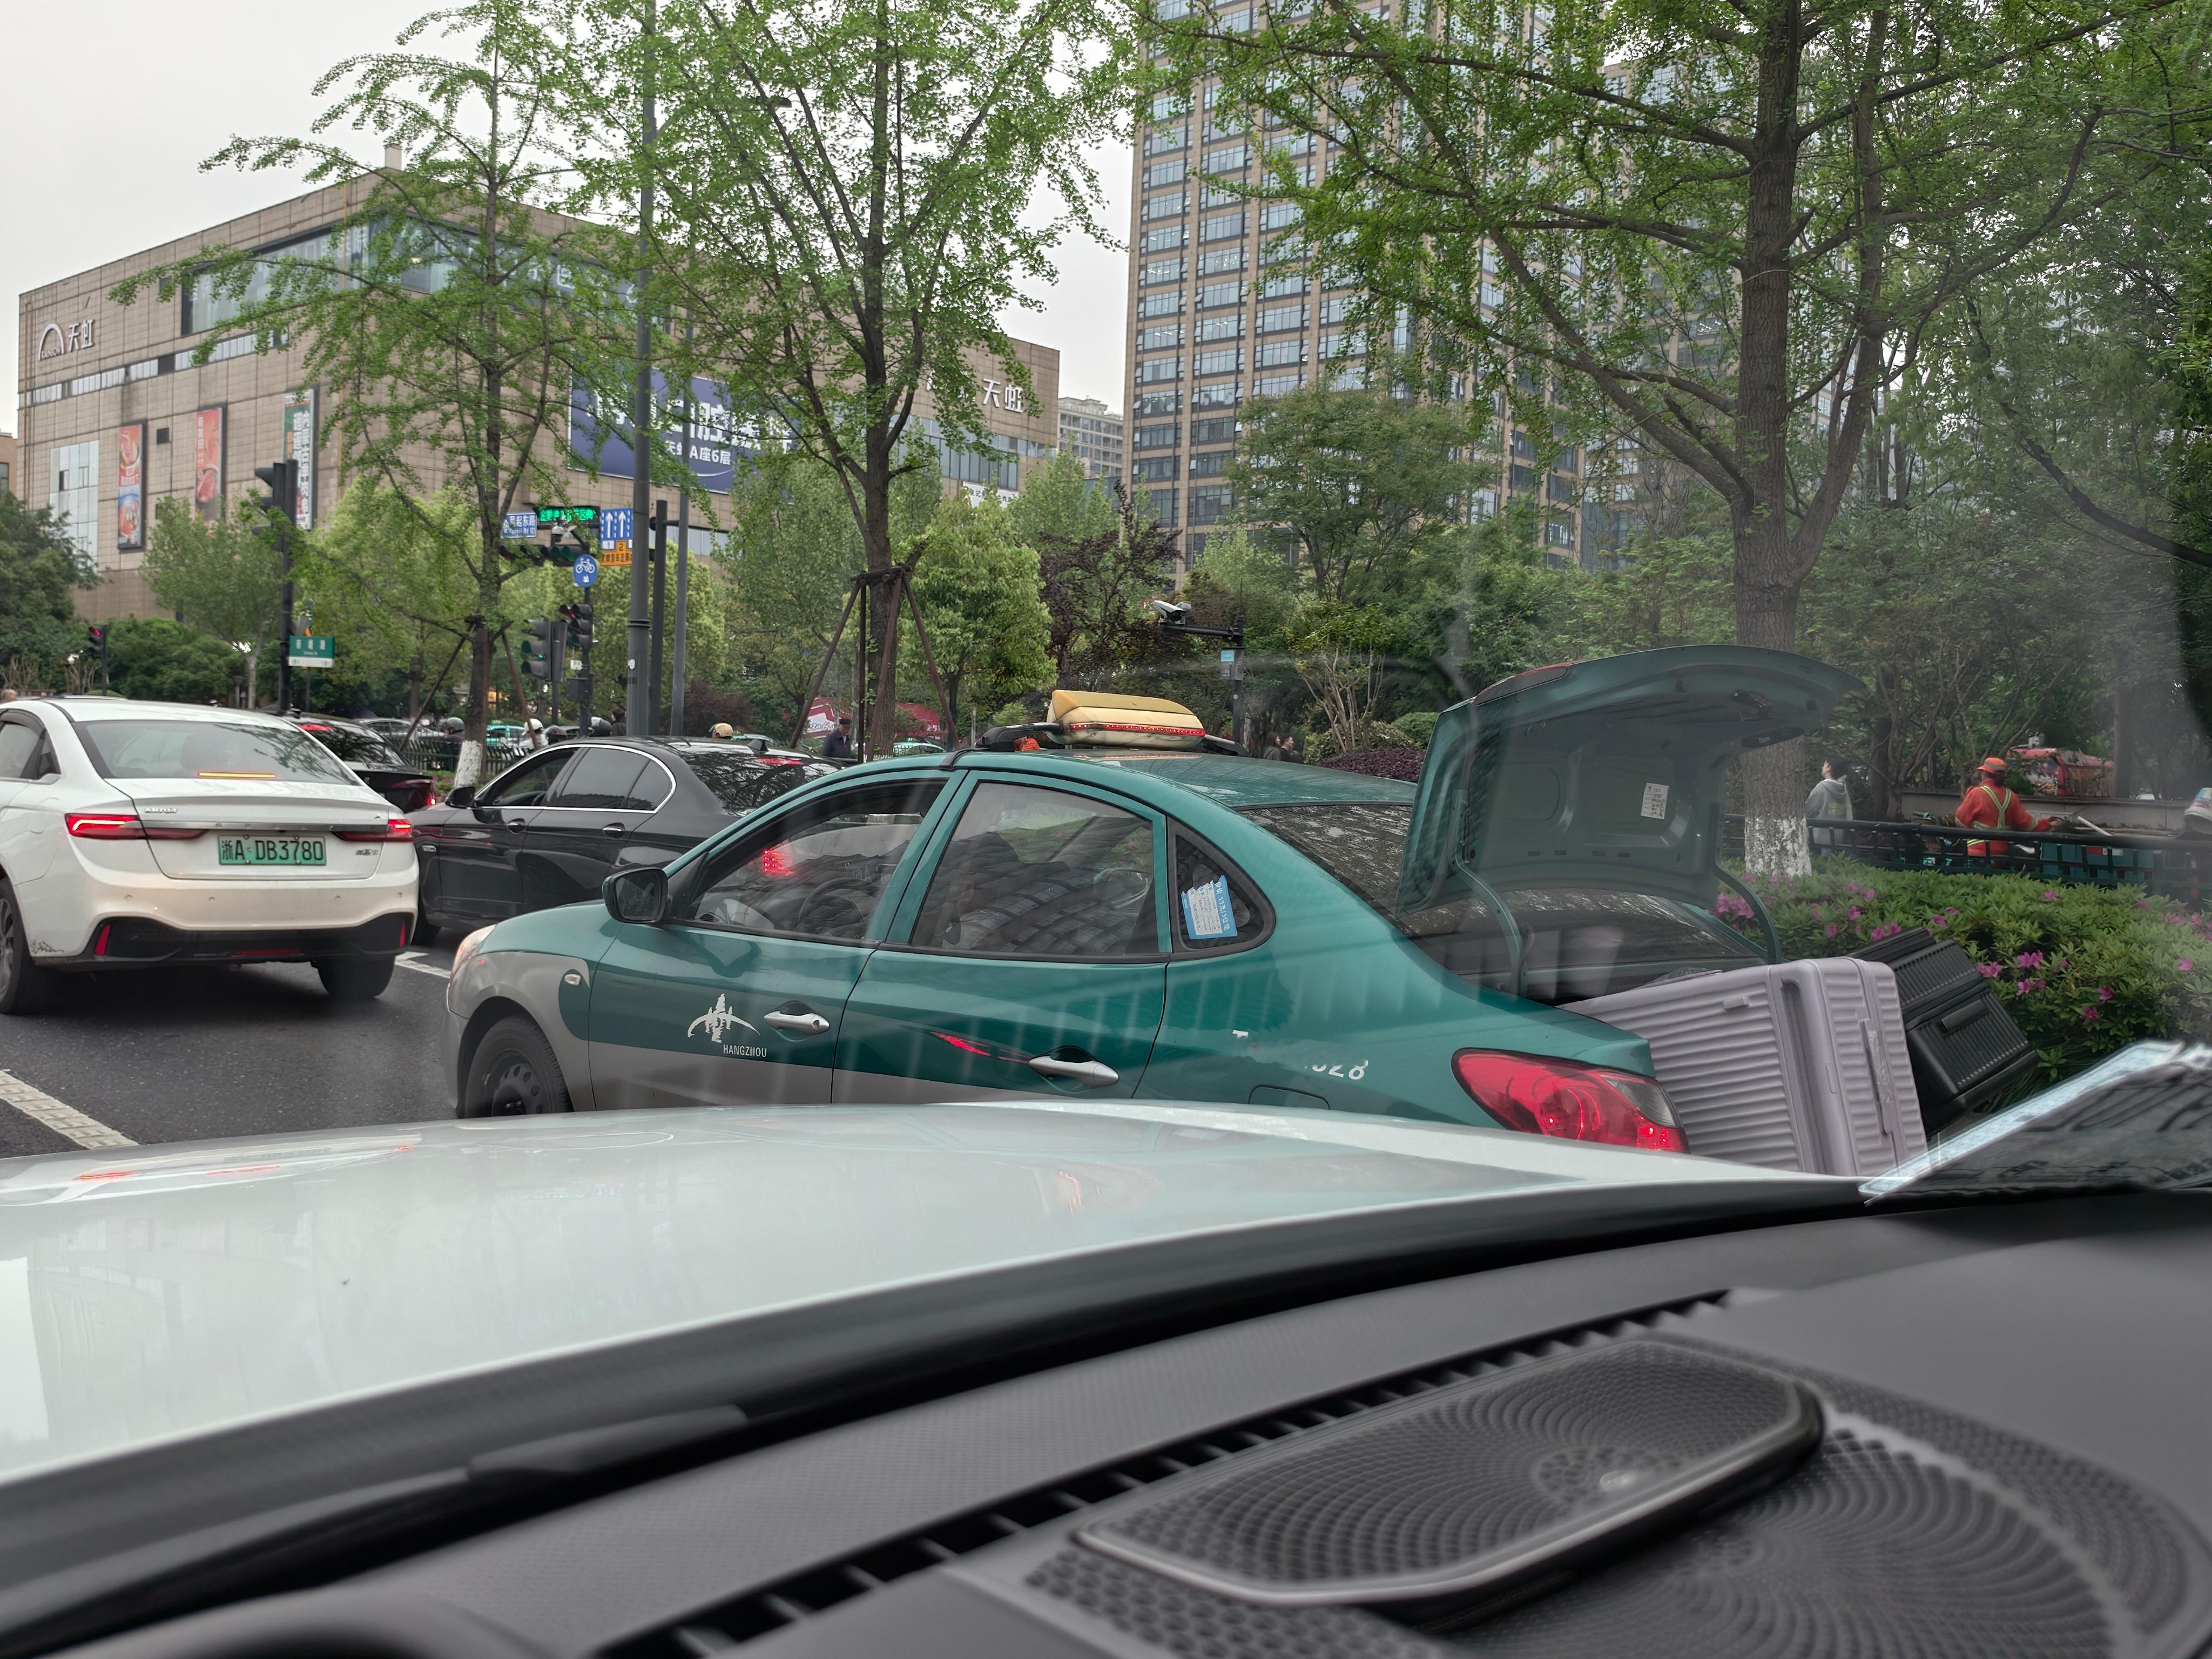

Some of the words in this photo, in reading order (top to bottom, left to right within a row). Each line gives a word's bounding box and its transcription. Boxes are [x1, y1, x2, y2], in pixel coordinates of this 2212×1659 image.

[68, 320, 93, 352] 天虹
[982, 378, 1023, 413] 天虹
[689, 446, 731, 466] A座6层
[618, 543, 624, 551] 2
